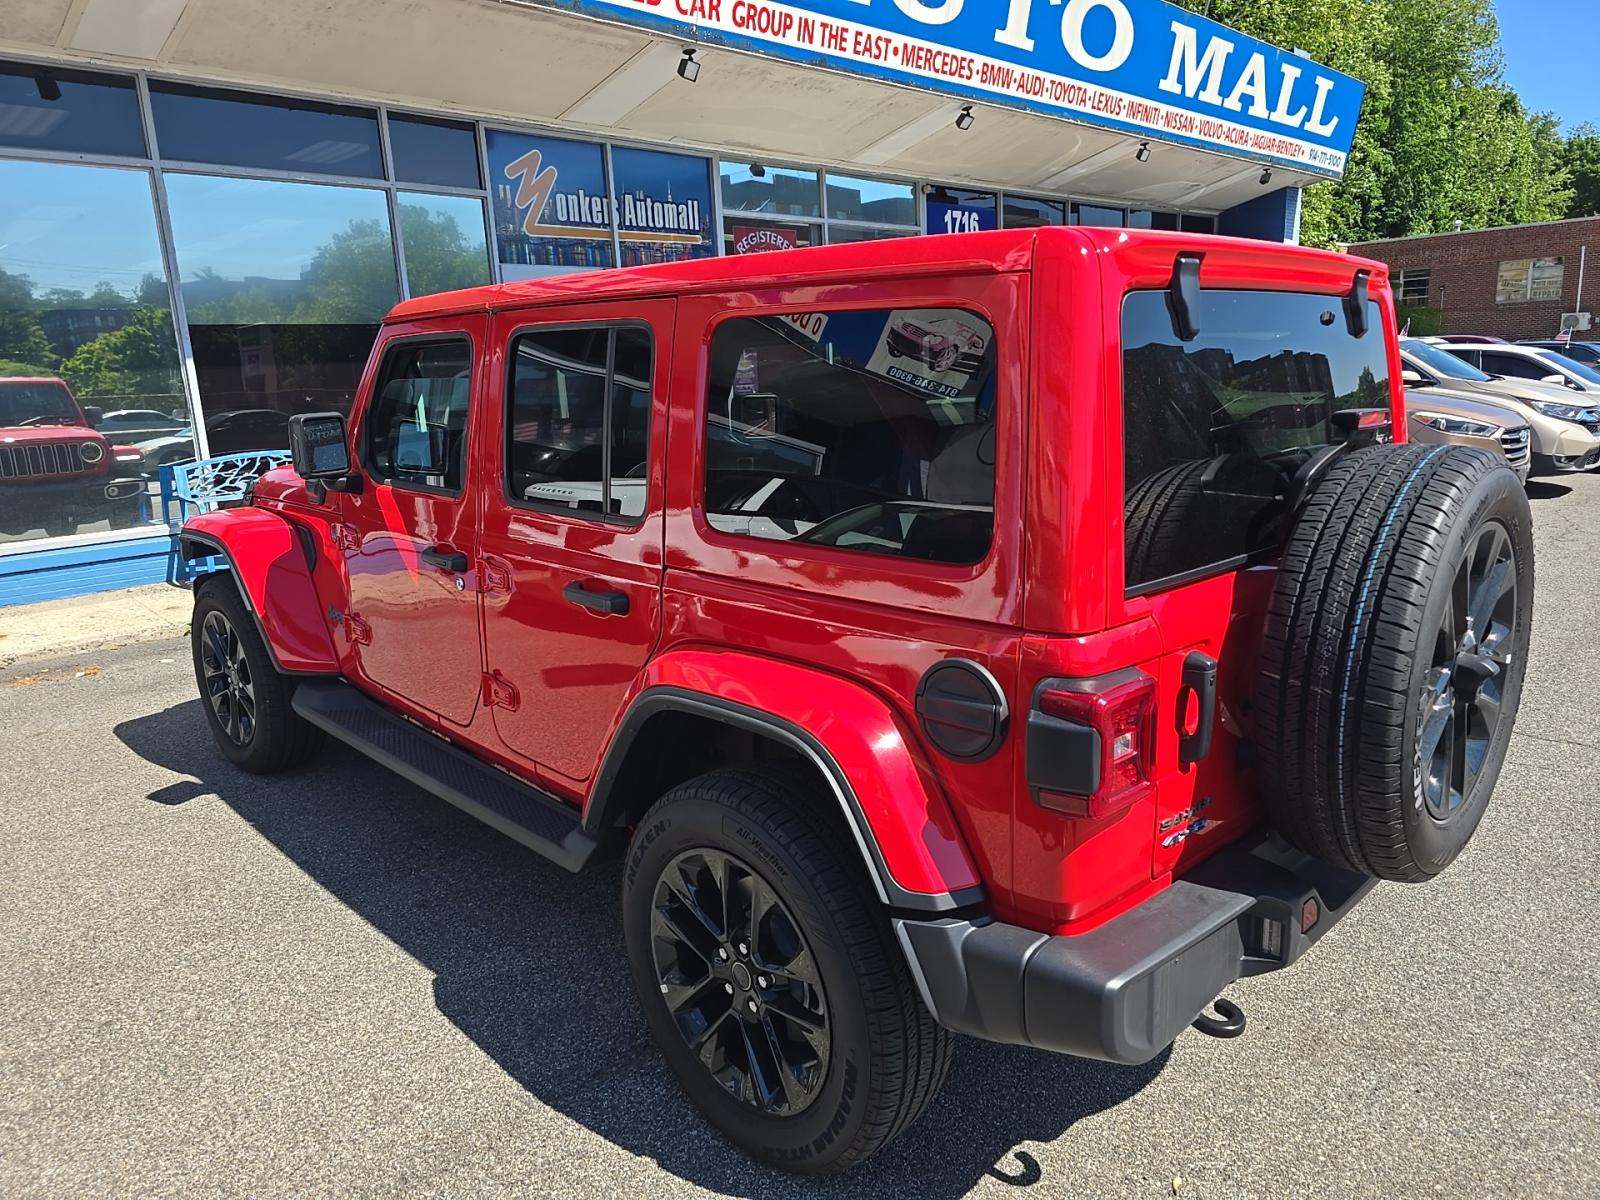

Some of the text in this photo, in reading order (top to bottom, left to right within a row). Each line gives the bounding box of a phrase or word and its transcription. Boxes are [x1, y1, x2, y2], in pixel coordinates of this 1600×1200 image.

[674, 0, 721, 21] CAR
[732, 1, 794, 38] GROUP
[797, 16, 815, 44] IN
[820, 22, 848, 52] THE
[853, 30, 892, 61] EAST
[901, 42, 976, 81] MERCEDES
[980, 62, 1015, 89] BMW
[1016, 72, 1046, 98] AUDI
[1049, 80, 1087, 107] TOYOTA
[1091, 90, 1123, 116] LEXUS
[1125, 100, 1161, 126] INFINITI
[1163, 110, 1196, 133] NISSAN
[1198, 119, 1223, 140] VOLVO
[1225, 126, 1250, 147] ACURA
[1250, 133, 1276, 152] JAGUAR
[1276, 139, 1303, 158] BENTLEY
[820, 0, 1339, 137] TO MALL
[624, 193, 700, 231] Automall
[944, 209, 979, 234] 1716
